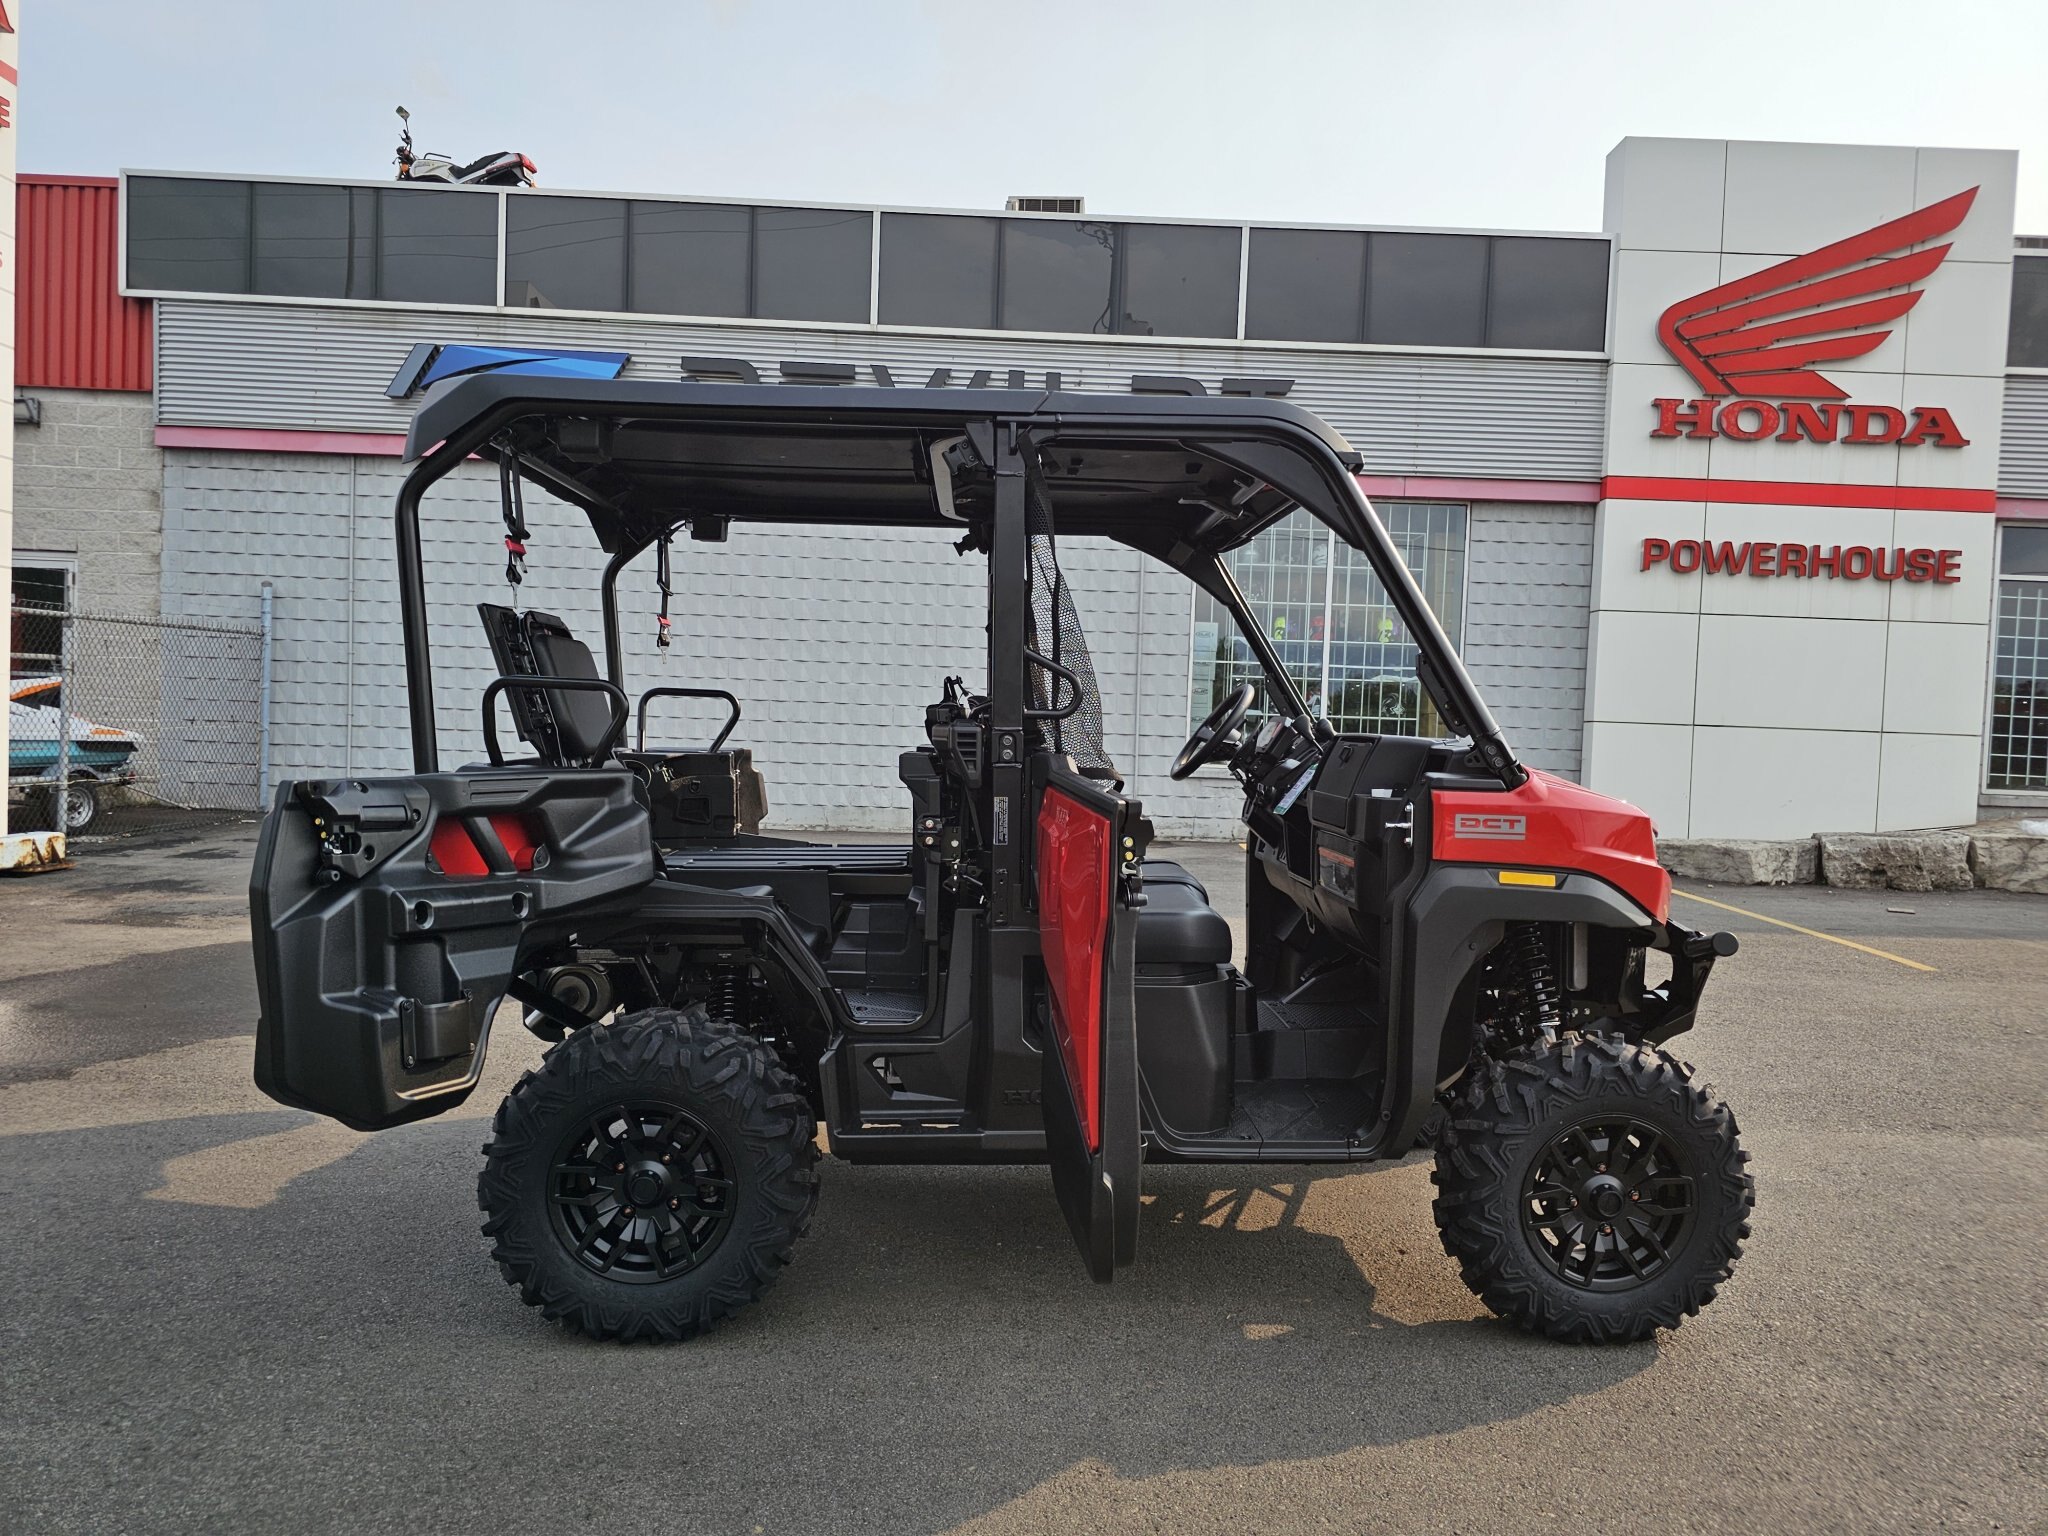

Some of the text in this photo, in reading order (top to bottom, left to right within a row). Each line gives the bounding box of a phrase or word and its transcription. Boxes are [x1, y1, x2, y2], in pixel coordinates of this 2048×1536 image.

[1650, 398, 1970, 448] HONDA
[1641, 538, 1963, 584] POWERHOUSE
[1460, 817, 1522, 830] DCT
